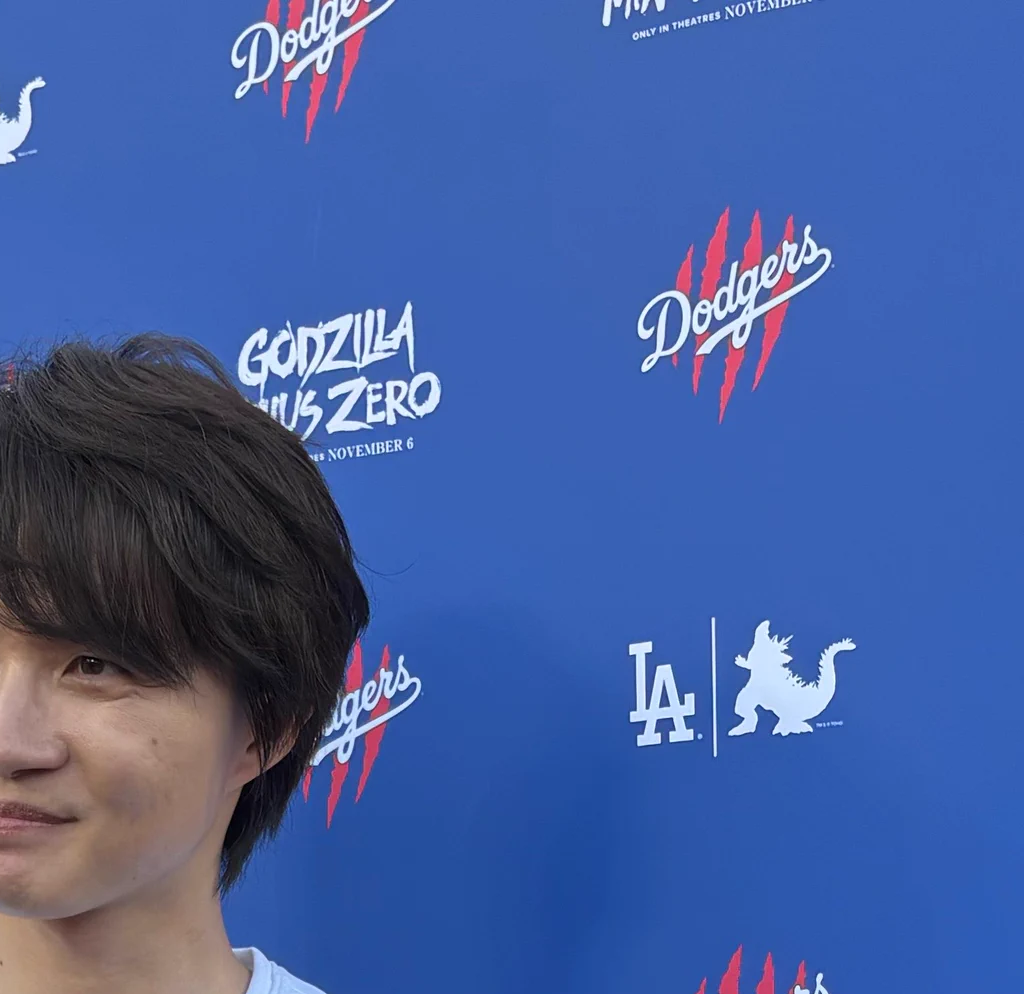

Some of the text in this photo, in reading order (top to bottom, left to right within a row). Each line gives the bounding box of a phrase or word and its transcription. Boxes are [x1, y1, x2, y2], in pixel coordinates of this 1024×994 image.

[230, 0, 396, 100] Dodge
[632, 28, 657, 41] ONLY
[659, 24, 670, 34] IN
[672, 11, 721, 30] THEATRES
[724, 0, 813, 20] NOVEMB
[637, 224, 832, 373] Dodgers
[238, 301, 415, 398] GODZILLA
[325, 372, 442, 435] ZERO
[328, 440, 403, 461] NOVEMBER
[406, 437, 414, 450] 6
[628, 640, 696, 747] LA
